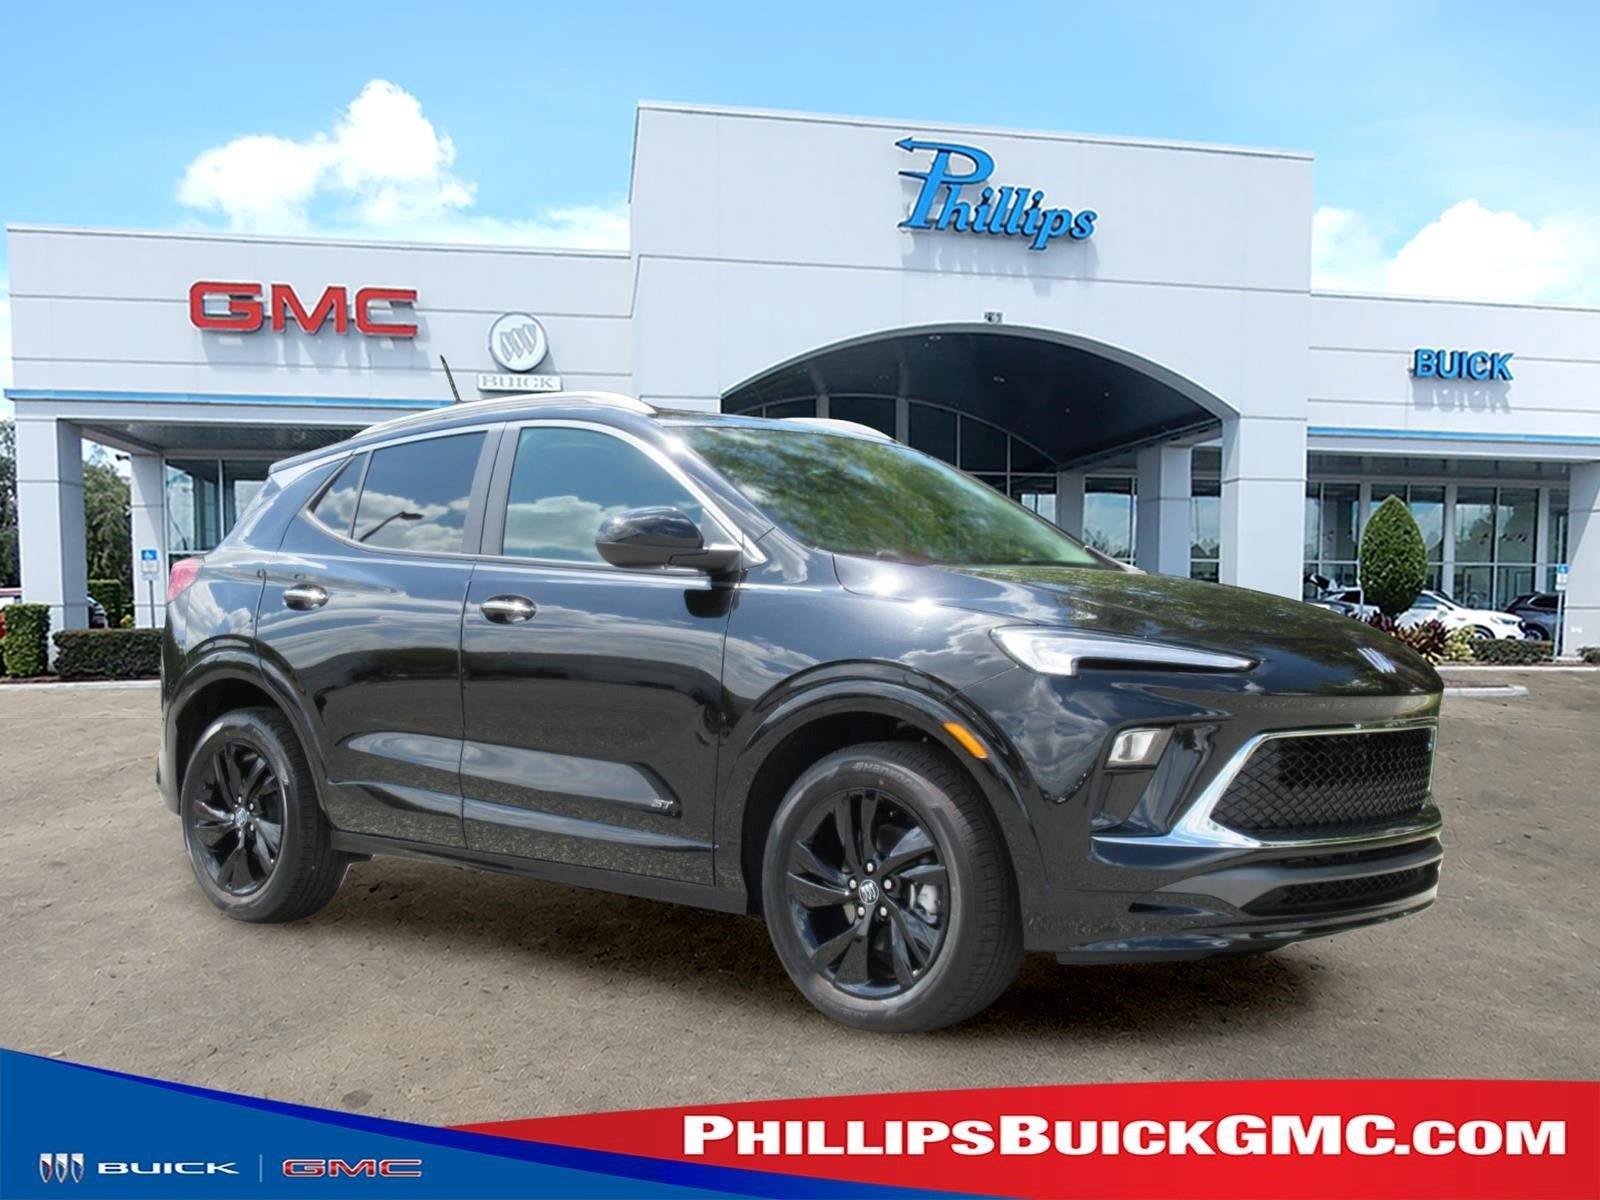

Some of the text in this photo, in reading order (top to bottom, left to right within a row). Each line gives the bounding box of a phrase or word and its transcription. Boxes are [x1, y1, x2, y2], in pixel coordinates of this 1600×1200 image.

[895, 137, 1098, 250] Phillips
[189, 281, 418, 338] GMC
[482, 375, 553, 388] BUICK
[1412, 347, 1514, 381] BUICK
